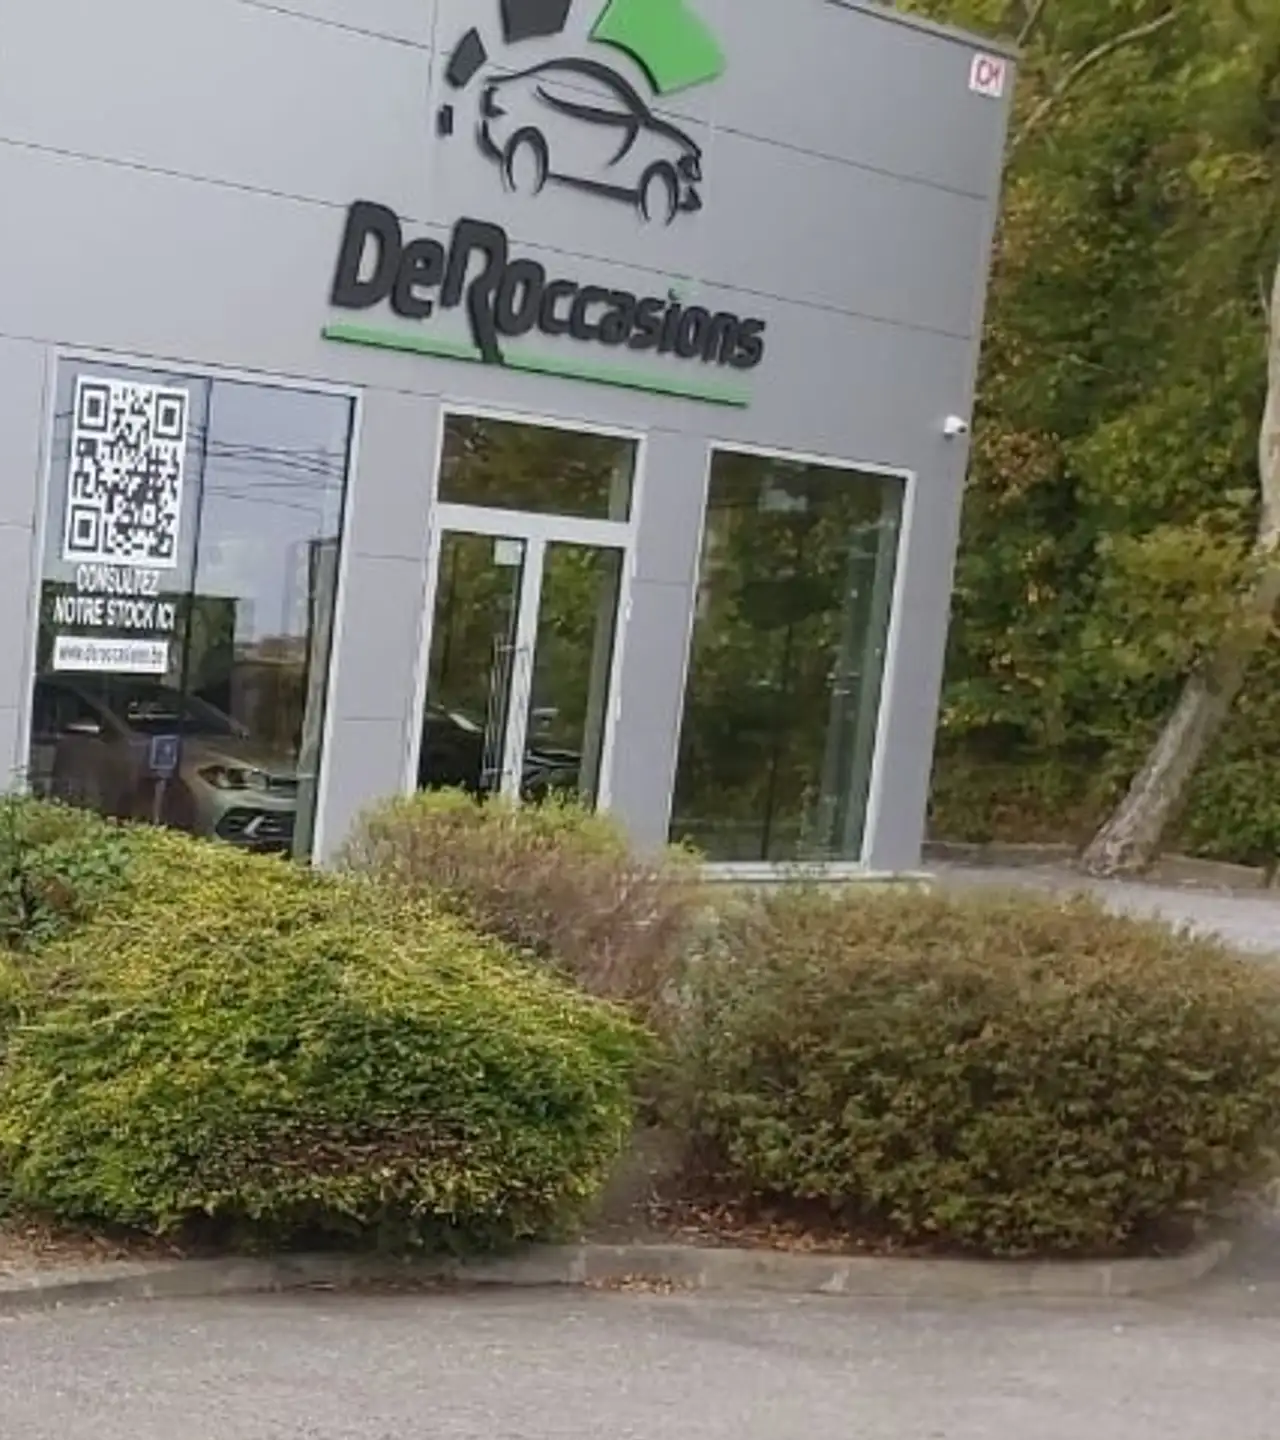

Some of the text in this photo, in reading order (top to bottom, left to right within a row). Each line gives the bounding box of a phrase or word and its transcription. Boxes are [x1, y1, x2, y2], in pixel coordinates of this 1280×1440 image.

[76, 564, 160, 596] CONSULTEZ
[53, 595, 105, 626] NOTRE
[106, 600, 155, 628] STOCK
